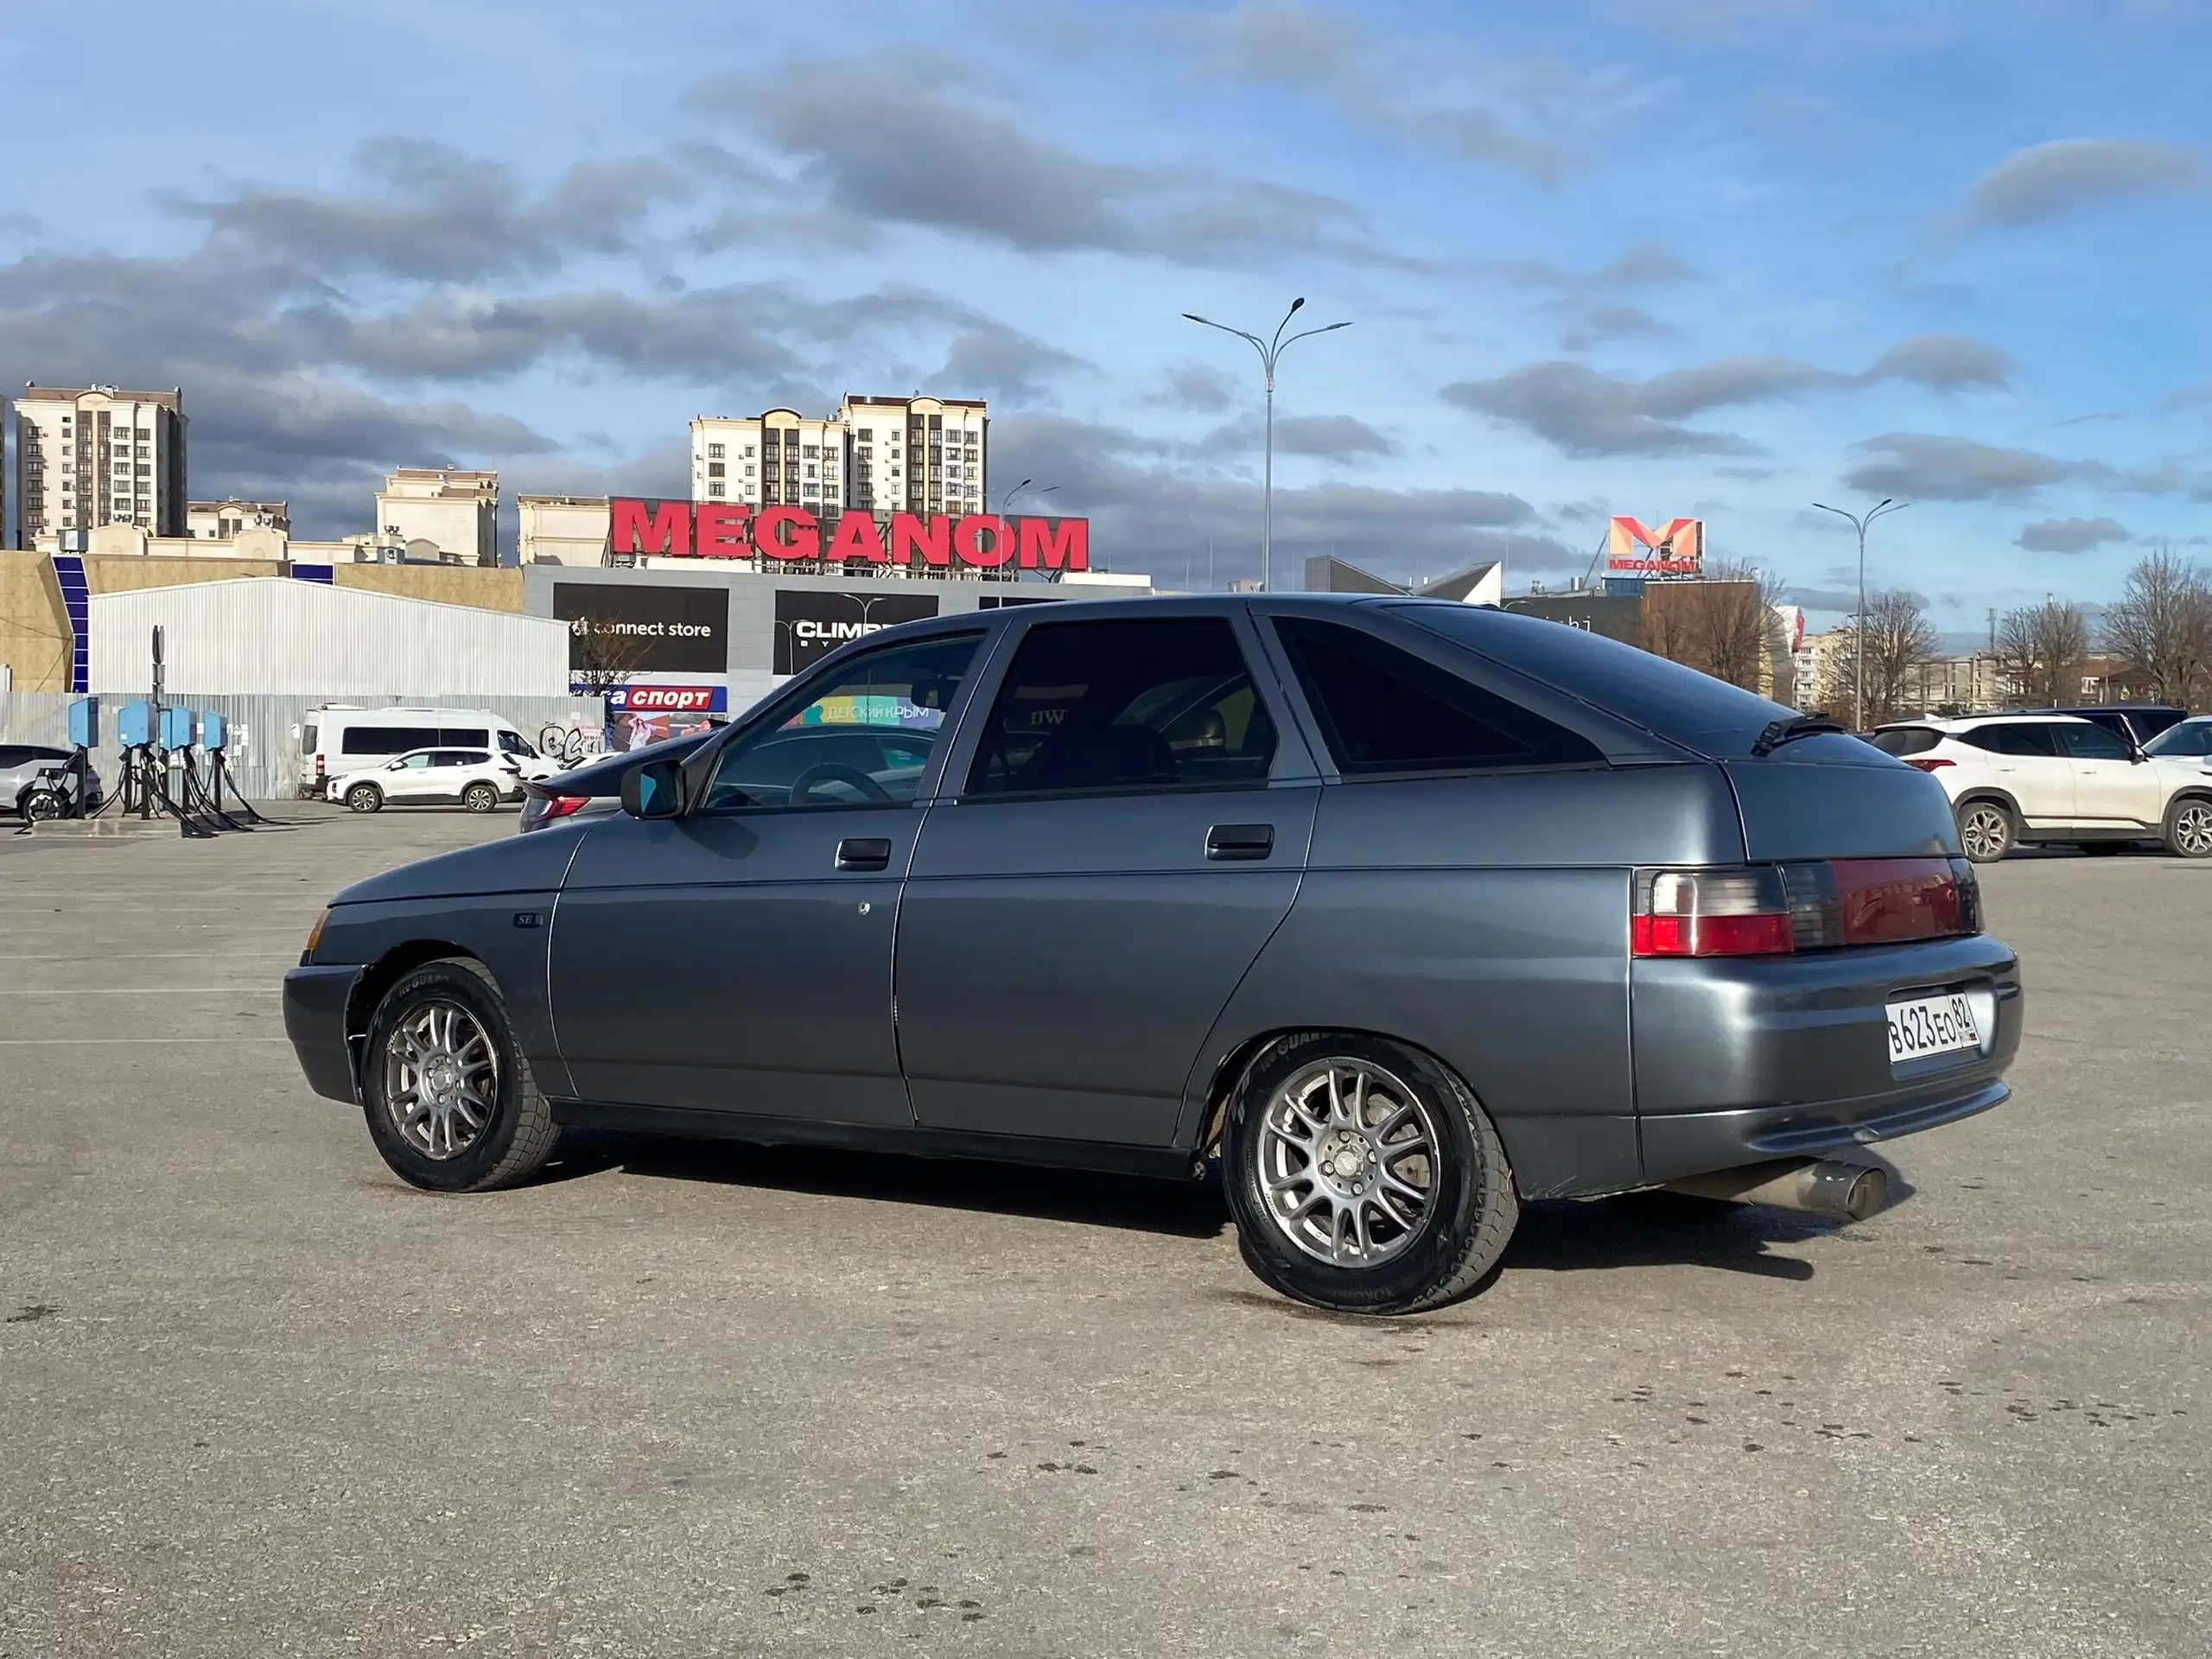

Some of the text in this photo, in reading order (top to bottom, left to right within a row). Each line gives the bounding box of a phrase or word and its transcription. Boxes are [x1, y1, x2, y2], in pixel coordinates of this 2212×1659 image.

[613, 498, 1089, 570] MEGANOM
[1608, 559, 1695, 572] MEGANOM
[668, 623, 712, 638] store
[632, 690, 710, 709] спорт
[885, 705, 930, 719] КРЫМ
